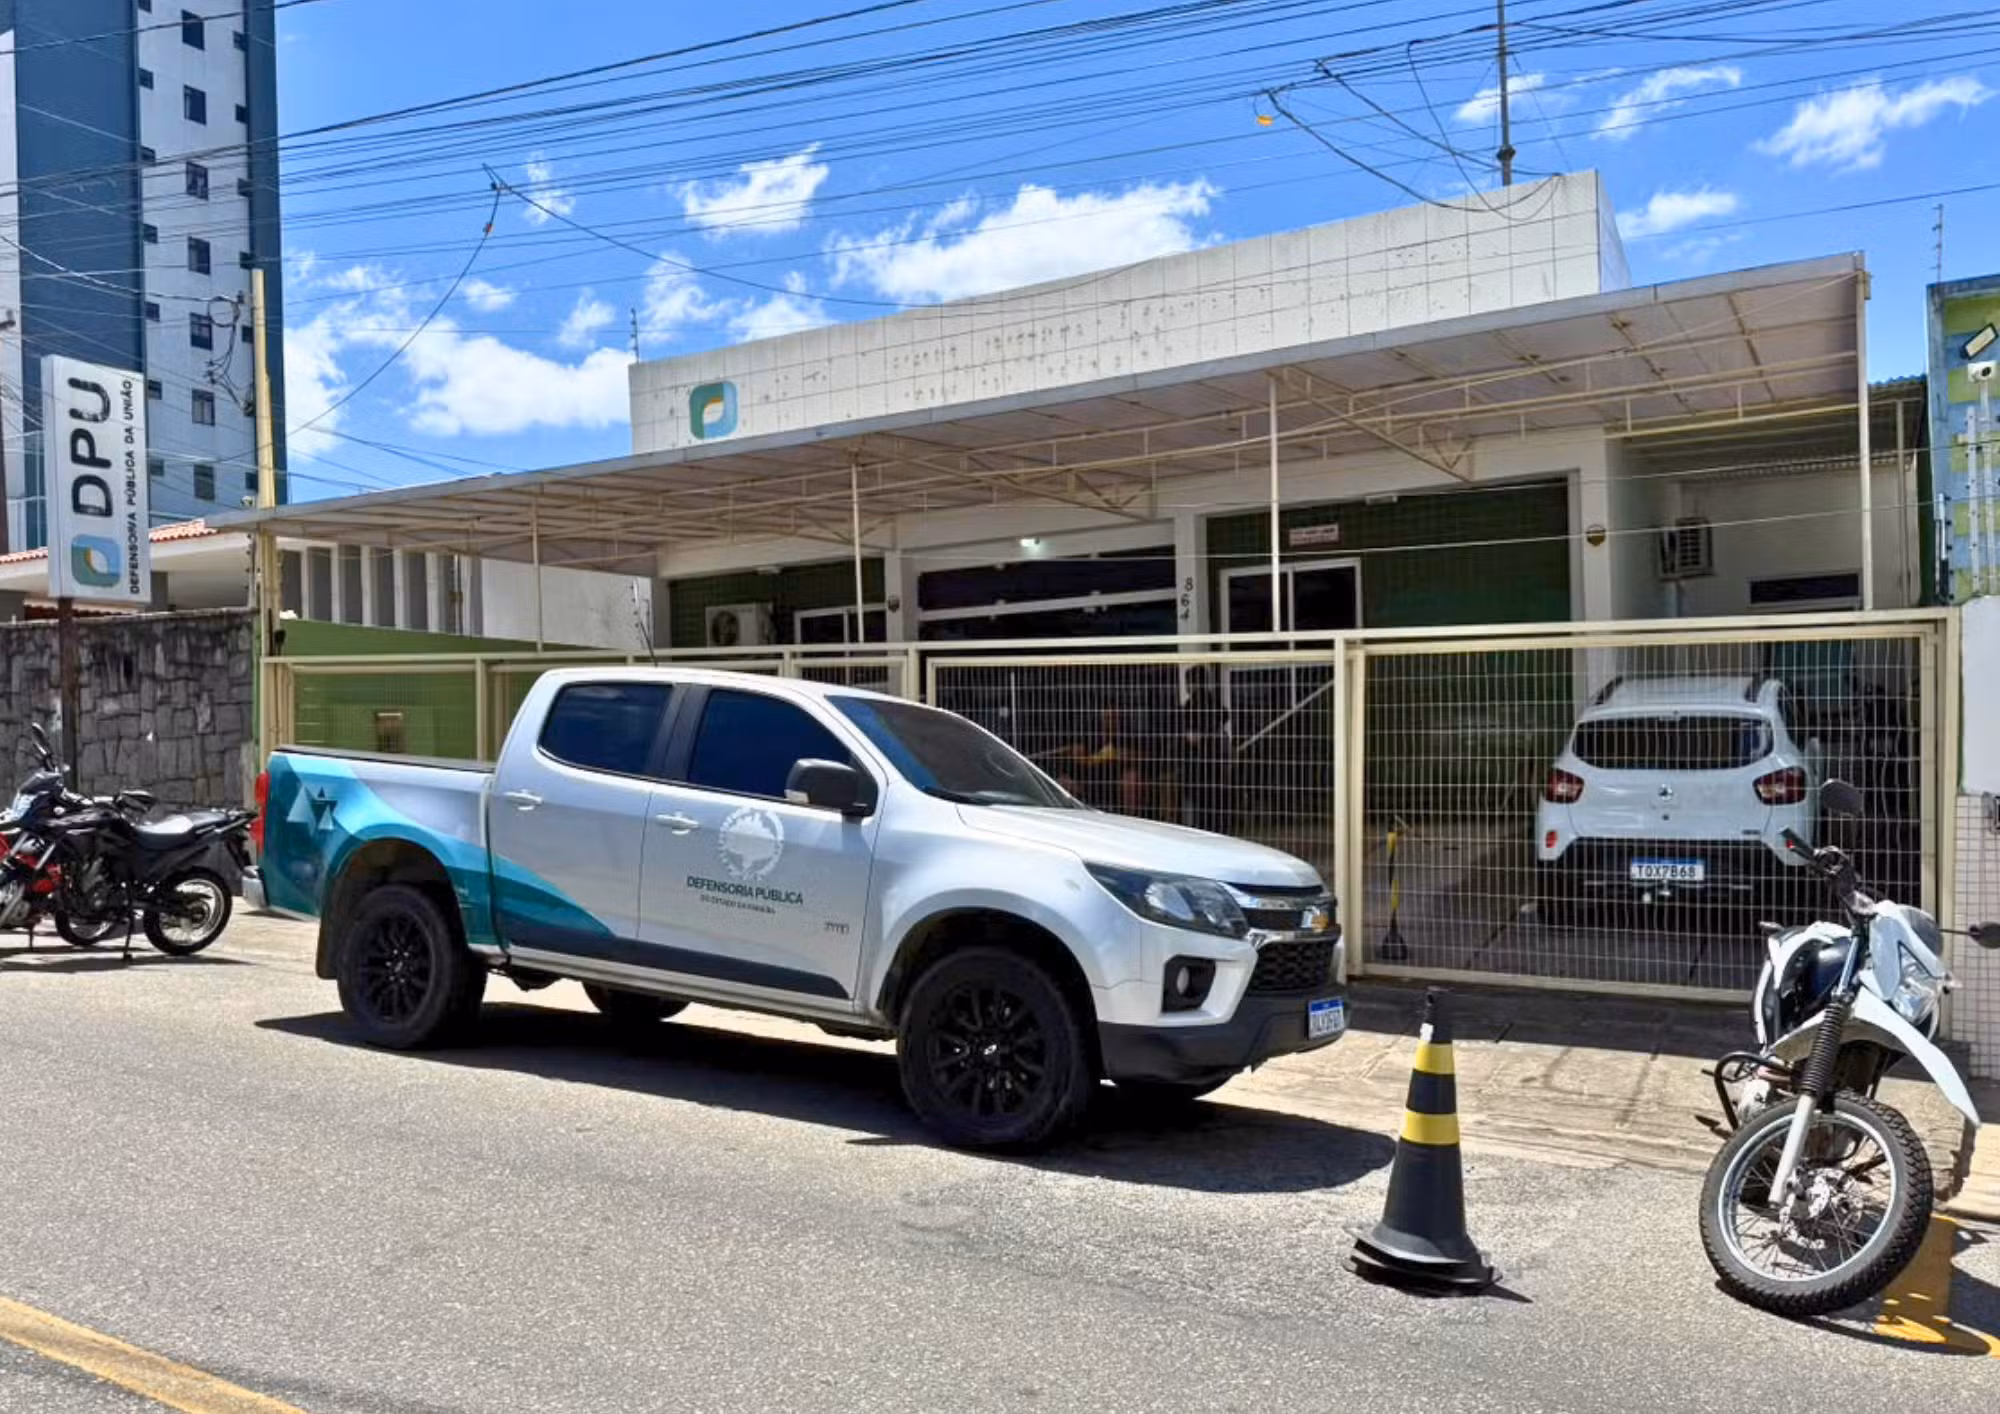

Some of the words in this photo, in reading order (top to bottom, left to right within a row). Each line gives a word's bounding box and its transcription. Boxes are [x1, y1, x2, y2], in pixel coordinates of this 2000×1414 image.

[120, 379, 134, 421] UNIÃO
[67, 377, 113, 517] DPU
[123, 425, 134, 445] DA
[124, 451, 137, 506] PÚBLICA
[1180, 577, 1194, 621] 864
[687, 876, 753, 897] DEFENSORIA
